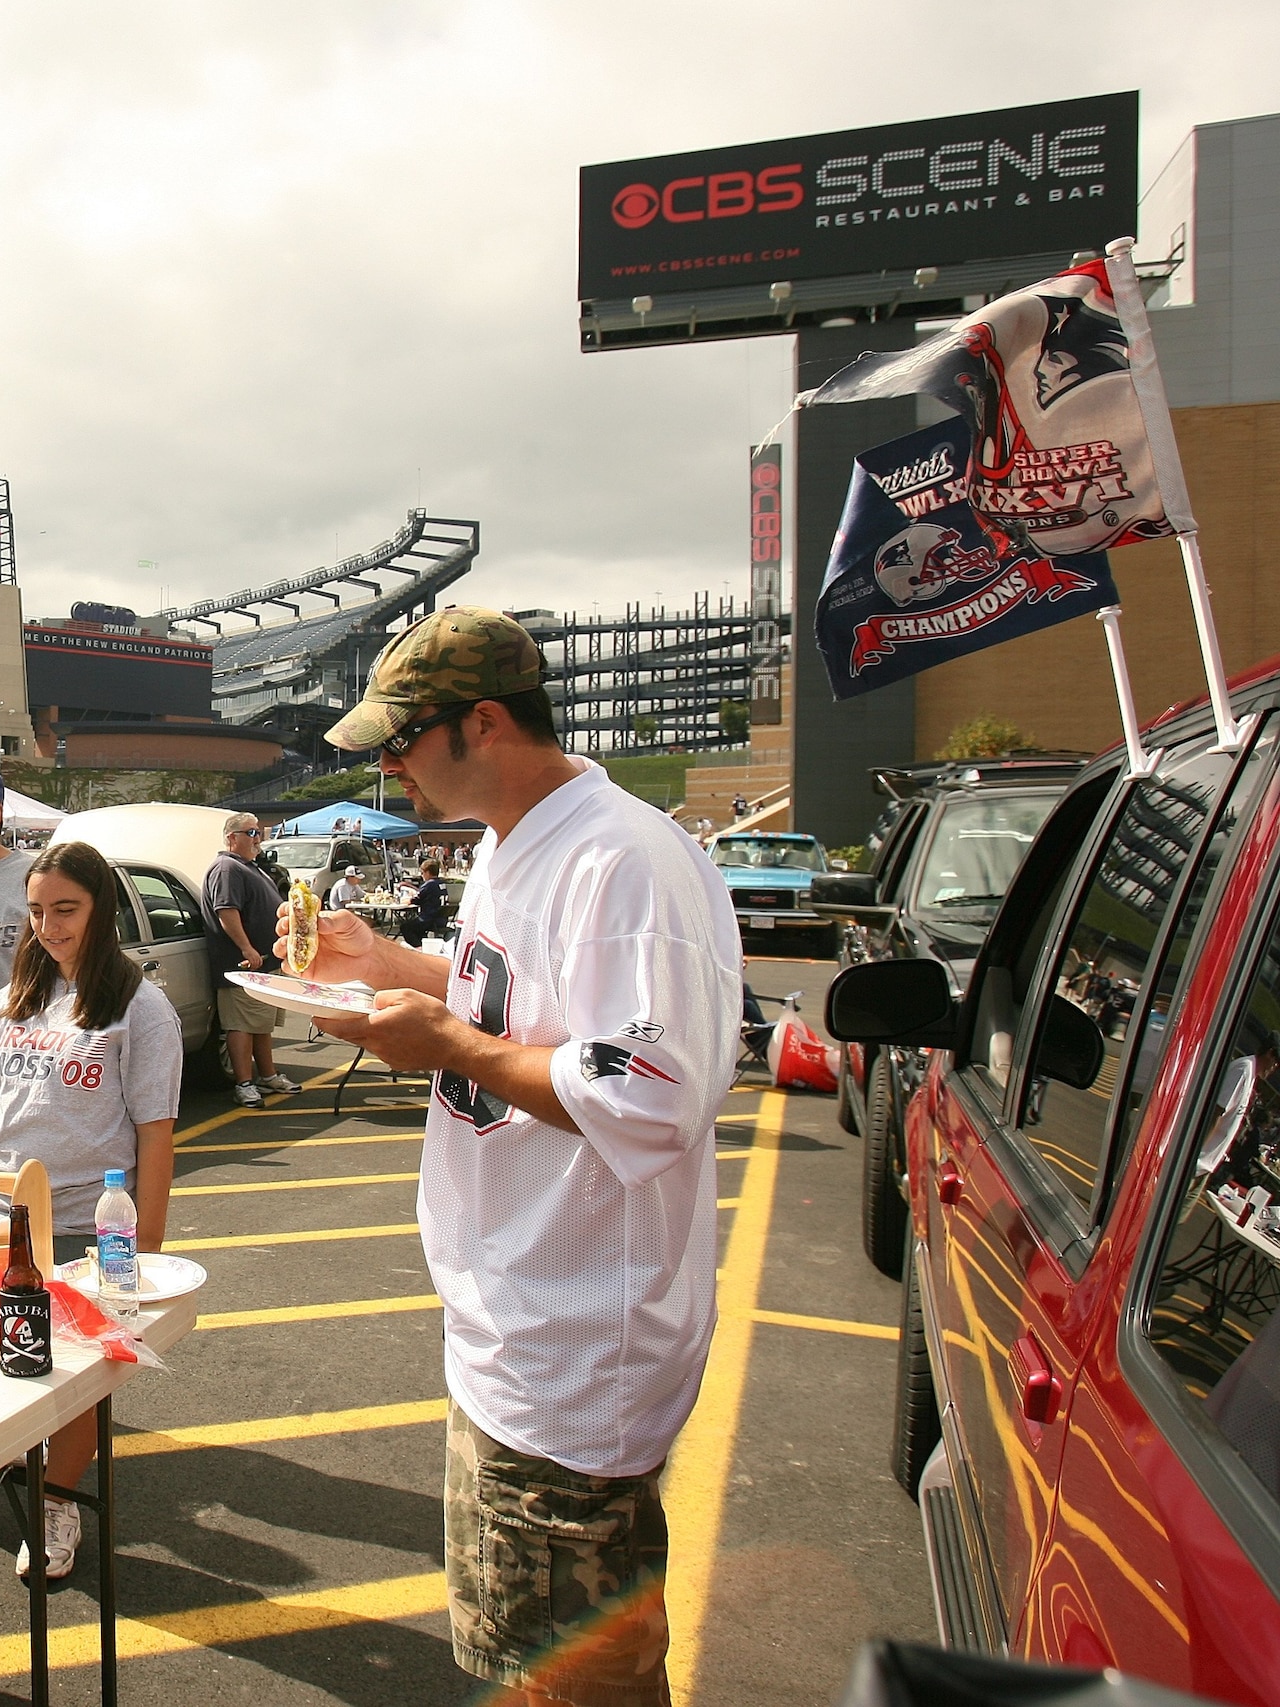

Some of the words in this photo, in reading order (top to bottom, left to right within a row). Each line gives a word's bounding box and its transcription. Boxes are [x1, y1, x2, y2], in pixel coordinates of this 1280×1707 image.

[661, 163, 804, 223] CBS
[815, 125, 1106, 206] SCENE
[815, 196, 997, 228] RESTAURANT
[1015, 193, 1031, 206] &
[1048, 184, 1105, 202] BAR
[610, 247, 801, 277] WWW.CBSSCENE.COM
[1013, 440, 1119, 467] SUPER
[1020, 457, 1120, 483] BOWL
[752, 489, 781, 562] CBS
[881, 570, 1028, 638] CHAMPIONS
[102, 623, 142, 637] STADIUM
[751, 567, 781, 700] SCENE
[24, 632, 39, 642] ME
[43, 634, 58, 644] OF
[61, 636, 81, 647] THE
[85, 639, 109, 650] NEW
[112, 642, 161, 655] ENGLAND
[164, 648, 213, 661] PATRIOTS
[0, 1305, 49, 1320] ARUBA
